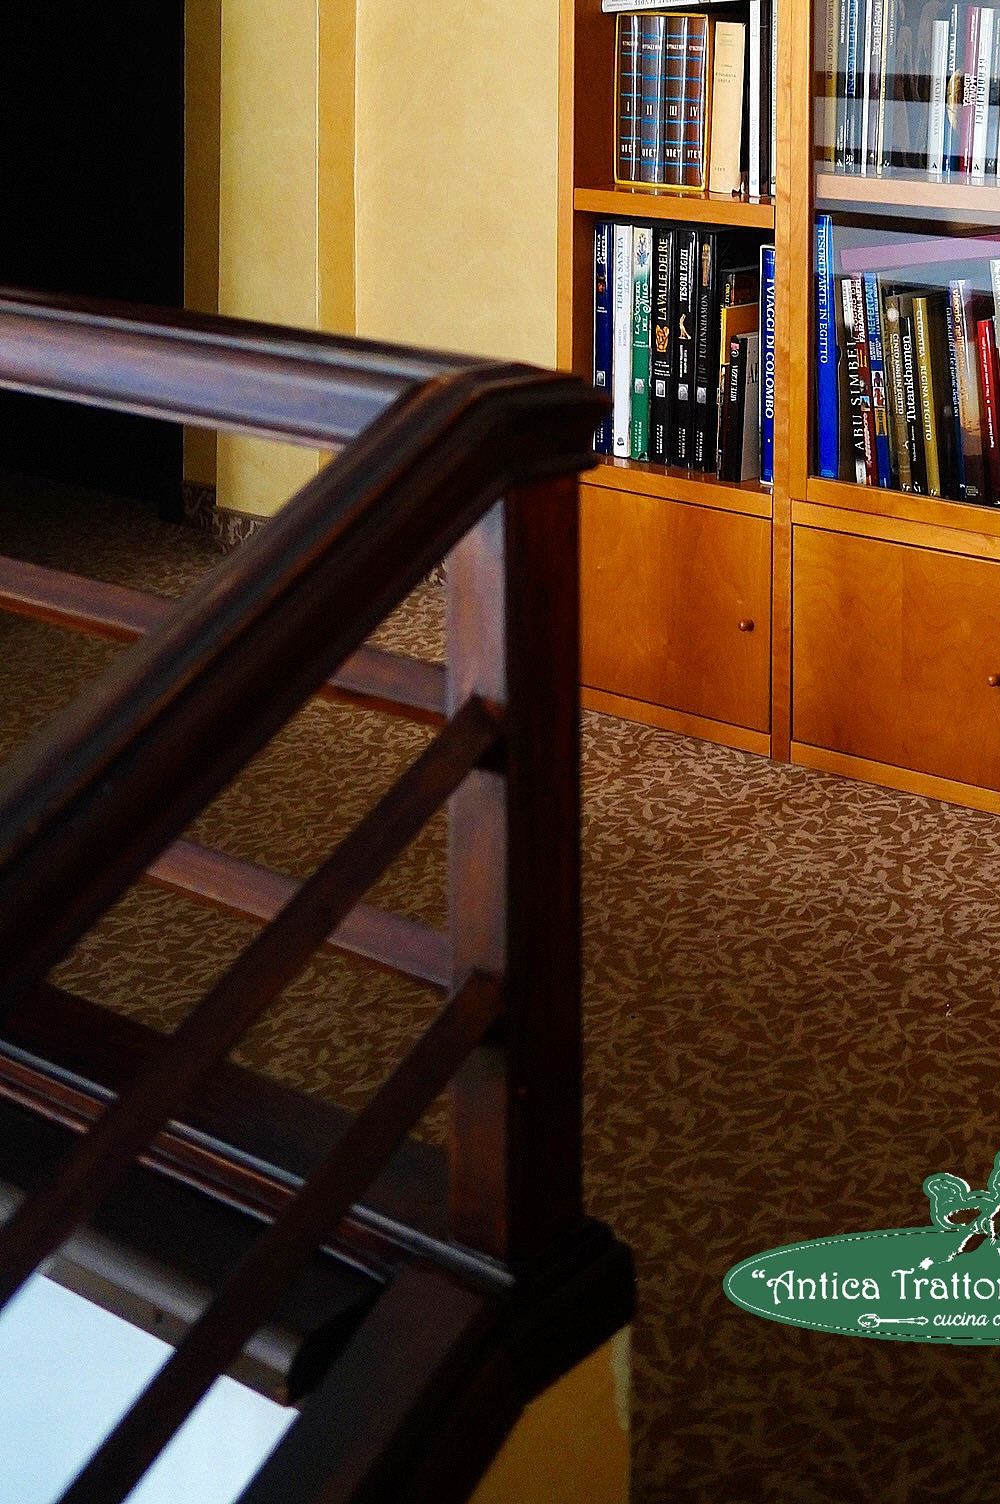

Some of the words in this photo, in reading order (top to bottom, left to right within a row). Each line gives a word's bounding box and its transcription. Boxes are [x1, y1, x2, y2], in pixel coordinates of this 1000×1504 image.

[975, 58, 987, 125] GEROGLIFICI
[646, 104, 653, 117] II
[669, 104, 679, 117] III
[690, 105, 699, 117] IV
[658, 238, 669, 253] RE
[681, 247, 690, 271] EGIZI
[817, 227, 829, 265] TESORI
[658, 253, 669, 274] DEI
[656, 274, 669, 305] VALLE
[680, 273, 689, 302] TESORI
[817, 267, 828, 306] D'ARTE
[855, 278, 864, 301] NERI
[657, 305, 668, 321] LA
[766, 283, 776, 335] VIAGGI
[817, 308, 828, 320] IN
[856, 301, 866, 343] FARAONI
[864, 281, 876, 335] NEFERTARI
[766, 336, 776, 350] DI
[817, 322, 828, 364] EGITTO
[892, 333, 901, 360] CENTO
[765, 352, 776, 420] COLOMBO
[847, 340, 862, 406] SIMBEL
[903, 335, 916, 423] Tutankhamen
[920, 365, 928, 398] REGINA
[896, 388, 904, 415] EGITTO
[850, 414, 865, 451] ABU
[923, 400, 932, 441] D'EGITTO
